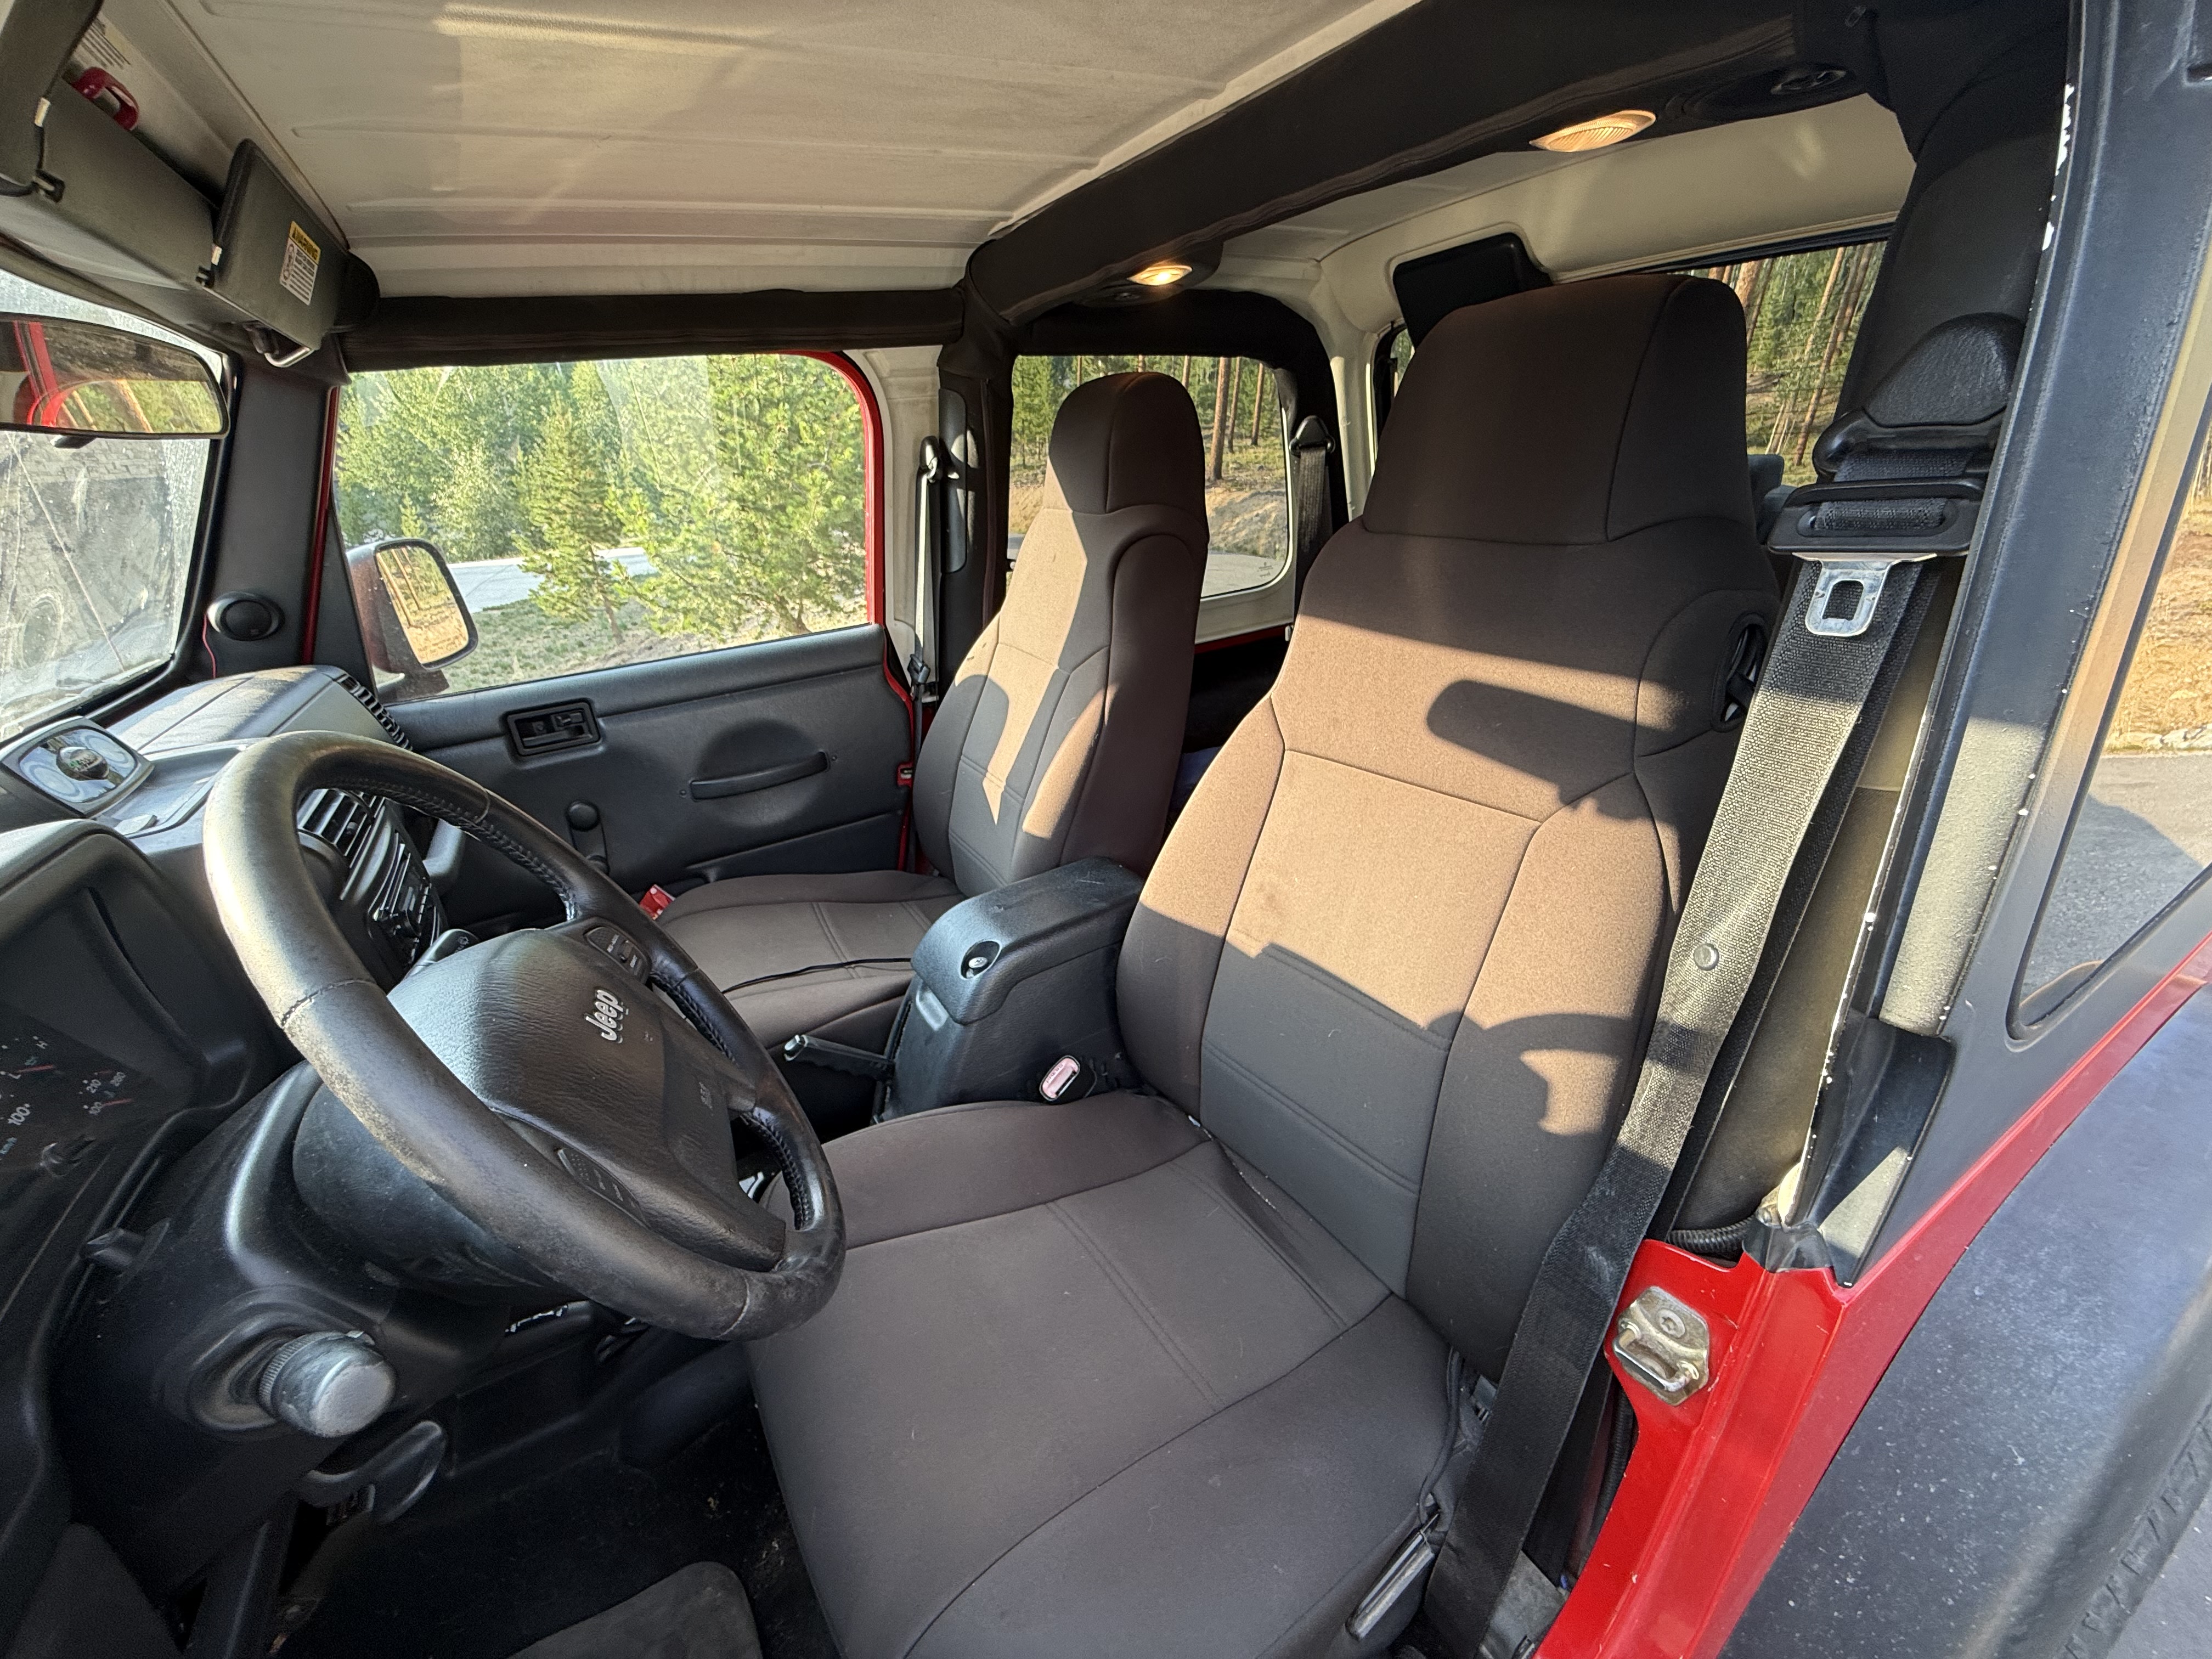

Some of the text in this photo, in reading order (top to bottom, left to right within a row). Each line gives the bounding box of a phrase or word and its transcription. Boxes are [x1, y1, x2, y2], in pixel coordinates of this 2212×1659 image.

[585, 989, 623, 1041] Jeep
[36, 1040, 48, 1049] H
[1046, 1064, 1063, 1084] PRESS
[86, 1079, 101, 1093] 210
[8, 1107, 30, 1125] 100
